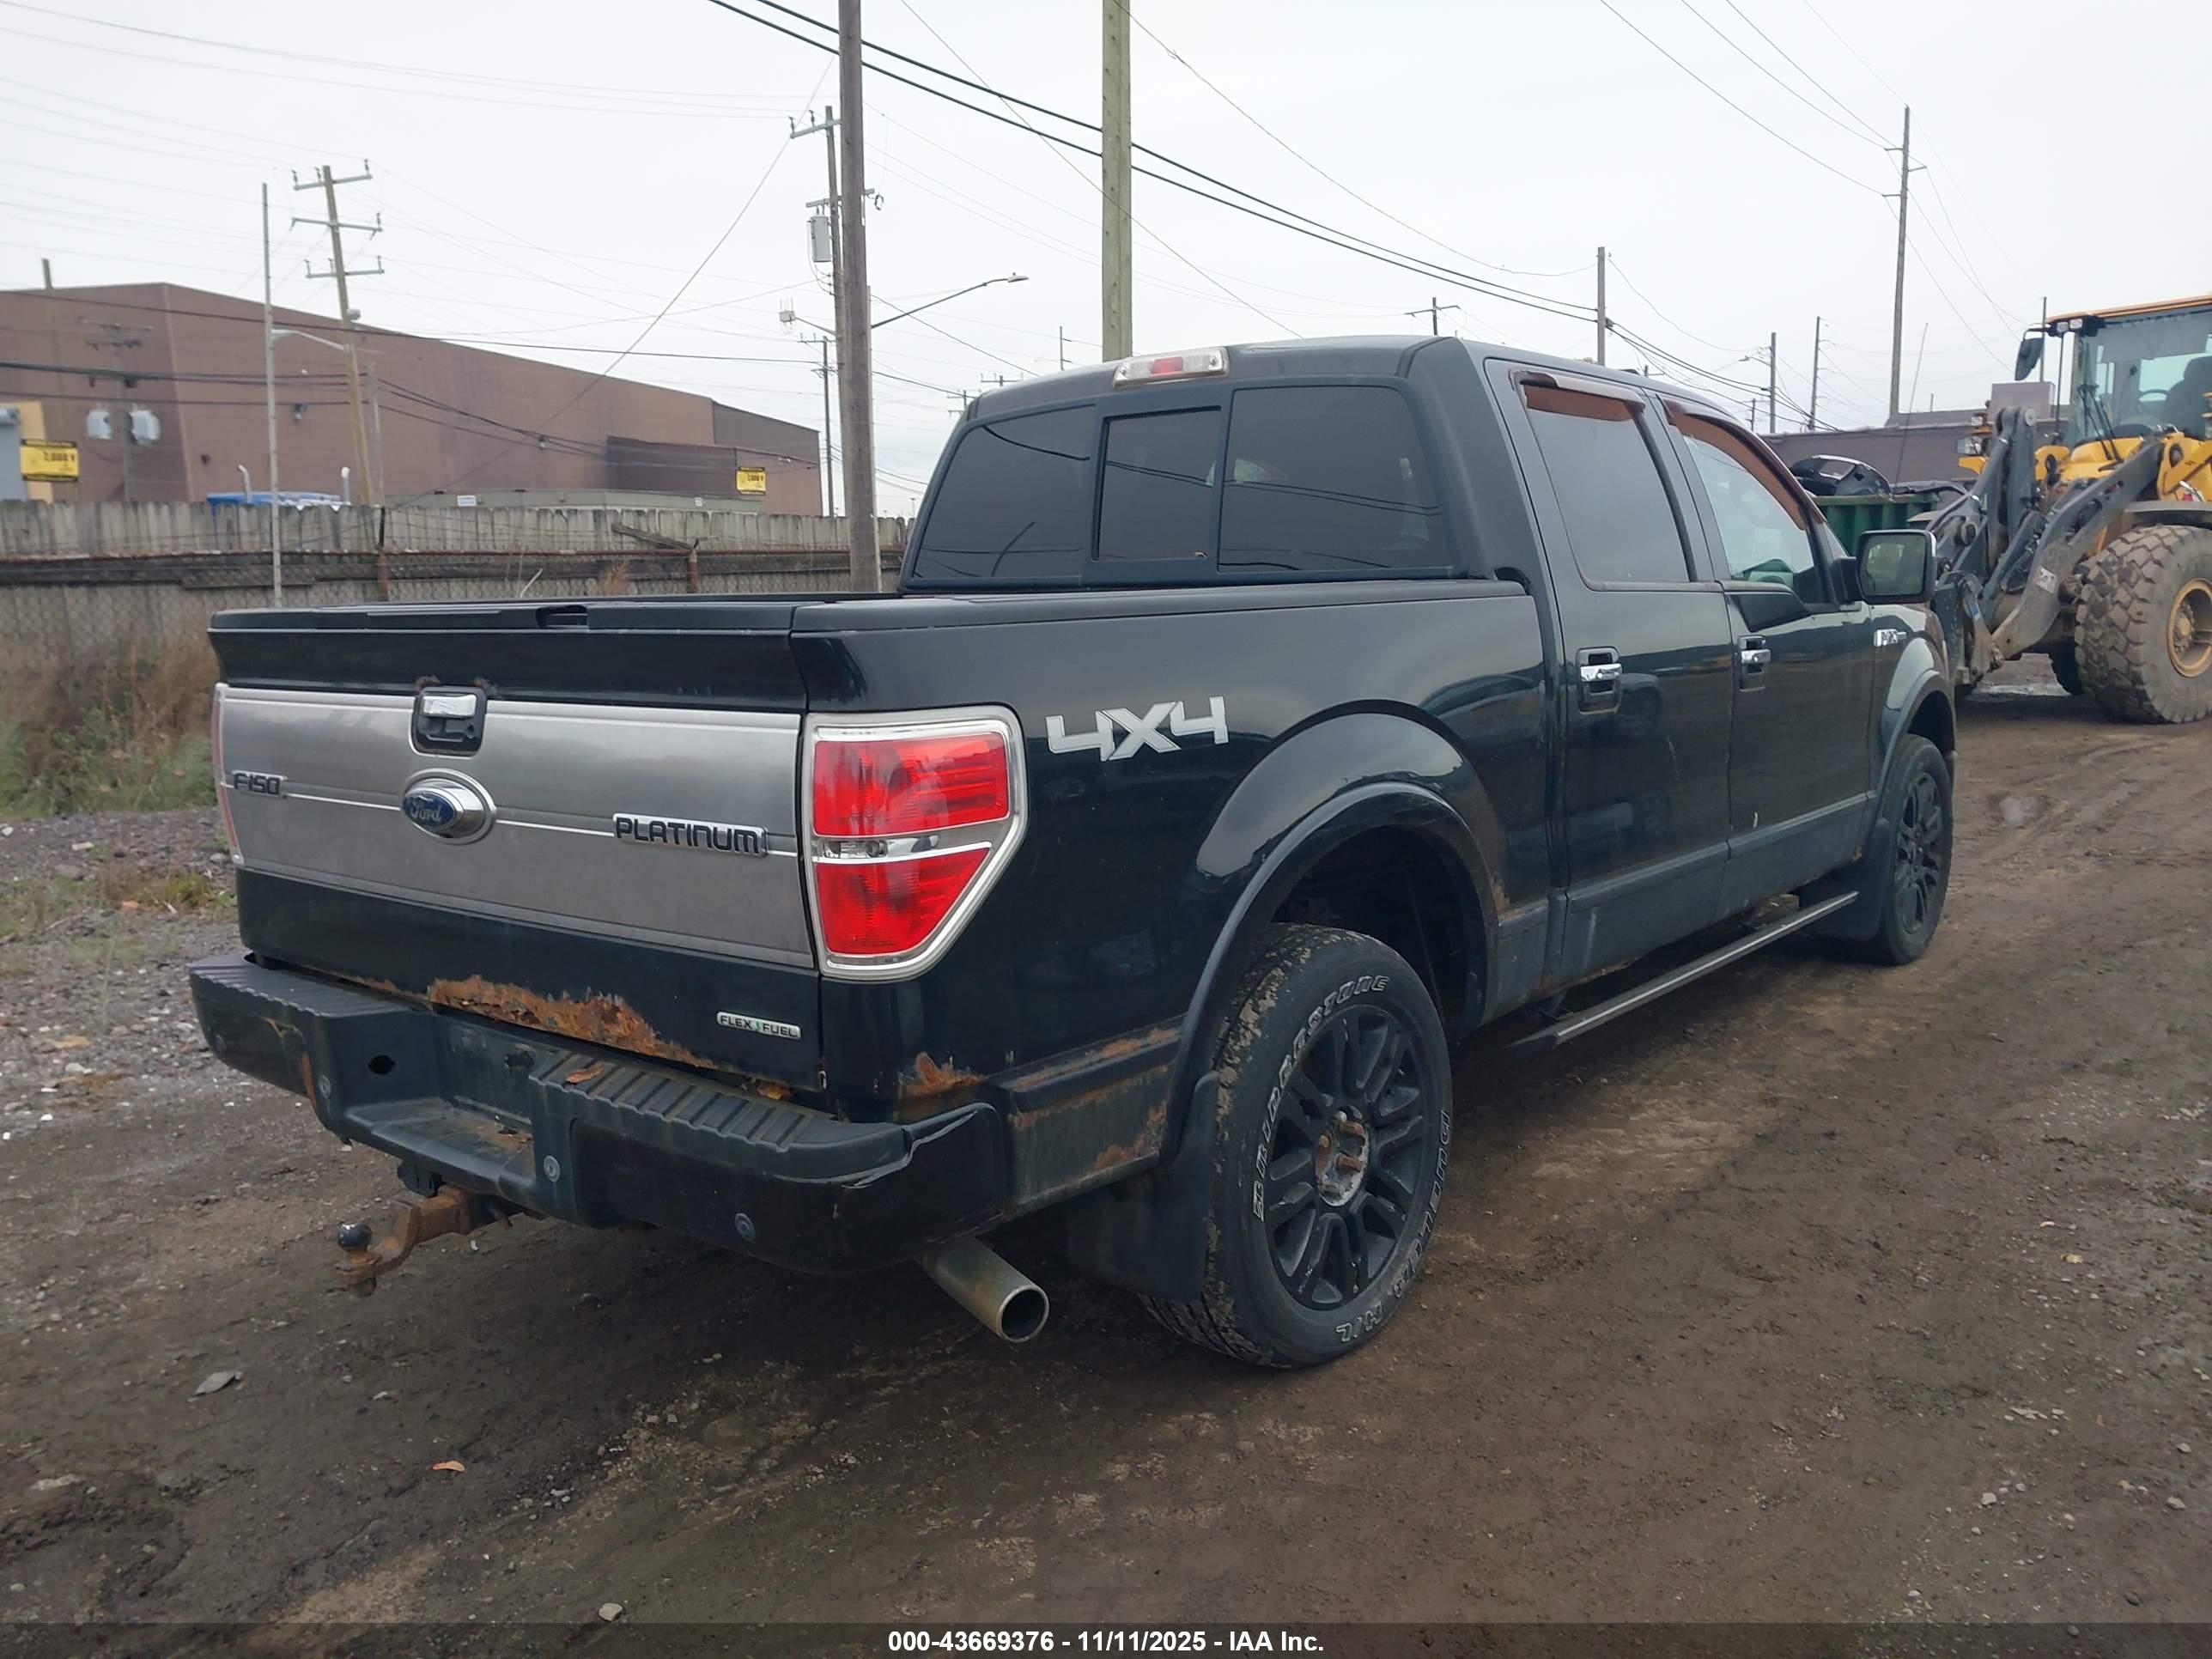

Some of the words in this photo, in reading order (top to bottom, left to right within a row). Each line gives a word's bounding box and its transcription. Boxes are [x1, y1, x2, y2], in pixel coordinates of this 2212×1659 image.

[1045, 696, 1229, 762] 4X4
[407, 792, 442, 821] Ford
[616, 817, 759, 854] PLATINUM
[720, 1015, 753, 1030] FLEX
[763, 1023, 798, 1038] FUEL
[1253, 975, 1389, 1223] BRIDGESTONE
